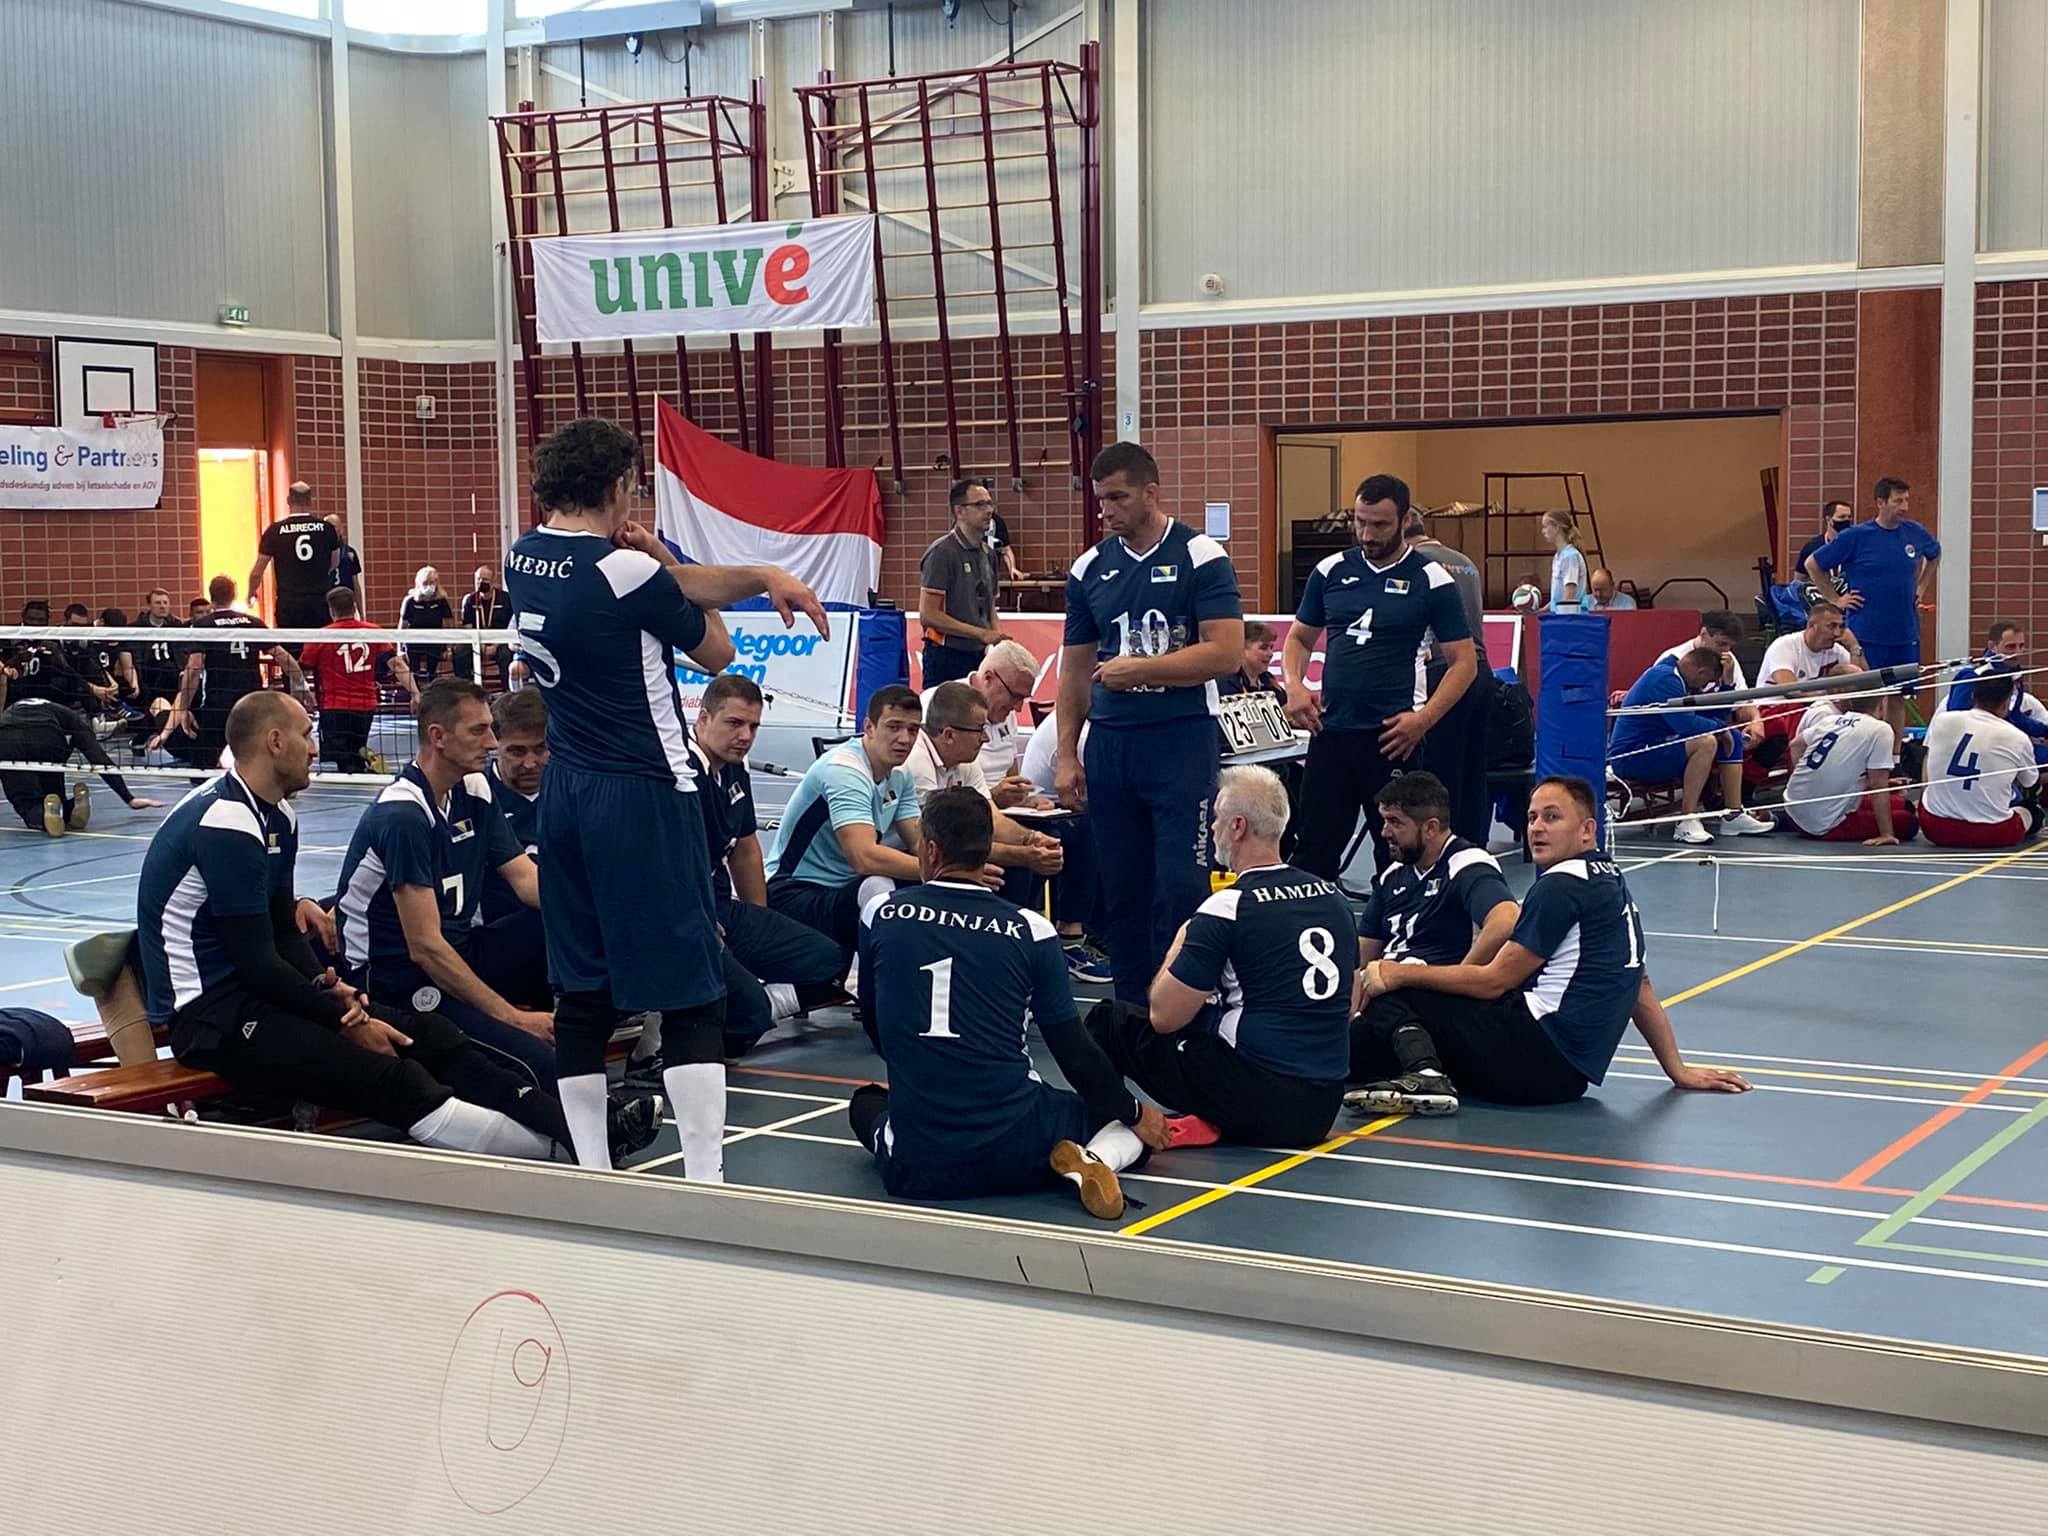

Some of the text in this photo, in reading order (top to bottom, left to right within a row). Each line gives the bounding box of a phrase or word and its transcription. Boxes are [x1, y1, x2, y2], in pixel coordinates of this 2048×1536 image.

[589, 222, 810, 315] univé
[54, 444, 74, 467] &
[279, 522, 325, 536] ALBRECHT
[294, 534, 314, 562] 6
[1110, 608, 1171, 658] 10
[1345, 608, 1374, 646] 4
[99, 651, 110, 668] 9
[151, 642, 170, 661] 11
[336, 642, 372, 674] 12
[517, 611, 561, 689] 5
[1224, 711, 1255, 746] 25
[1806, 731, 1840, 770] 8
[1946, 732, 1981, 791] 4
[441, 872, 465, 917] 7
[879, 903, 1025, 940] GODINJAK
[1298, 926, 1340, 1000] 8
[918, 956, 961, 1038] 1
